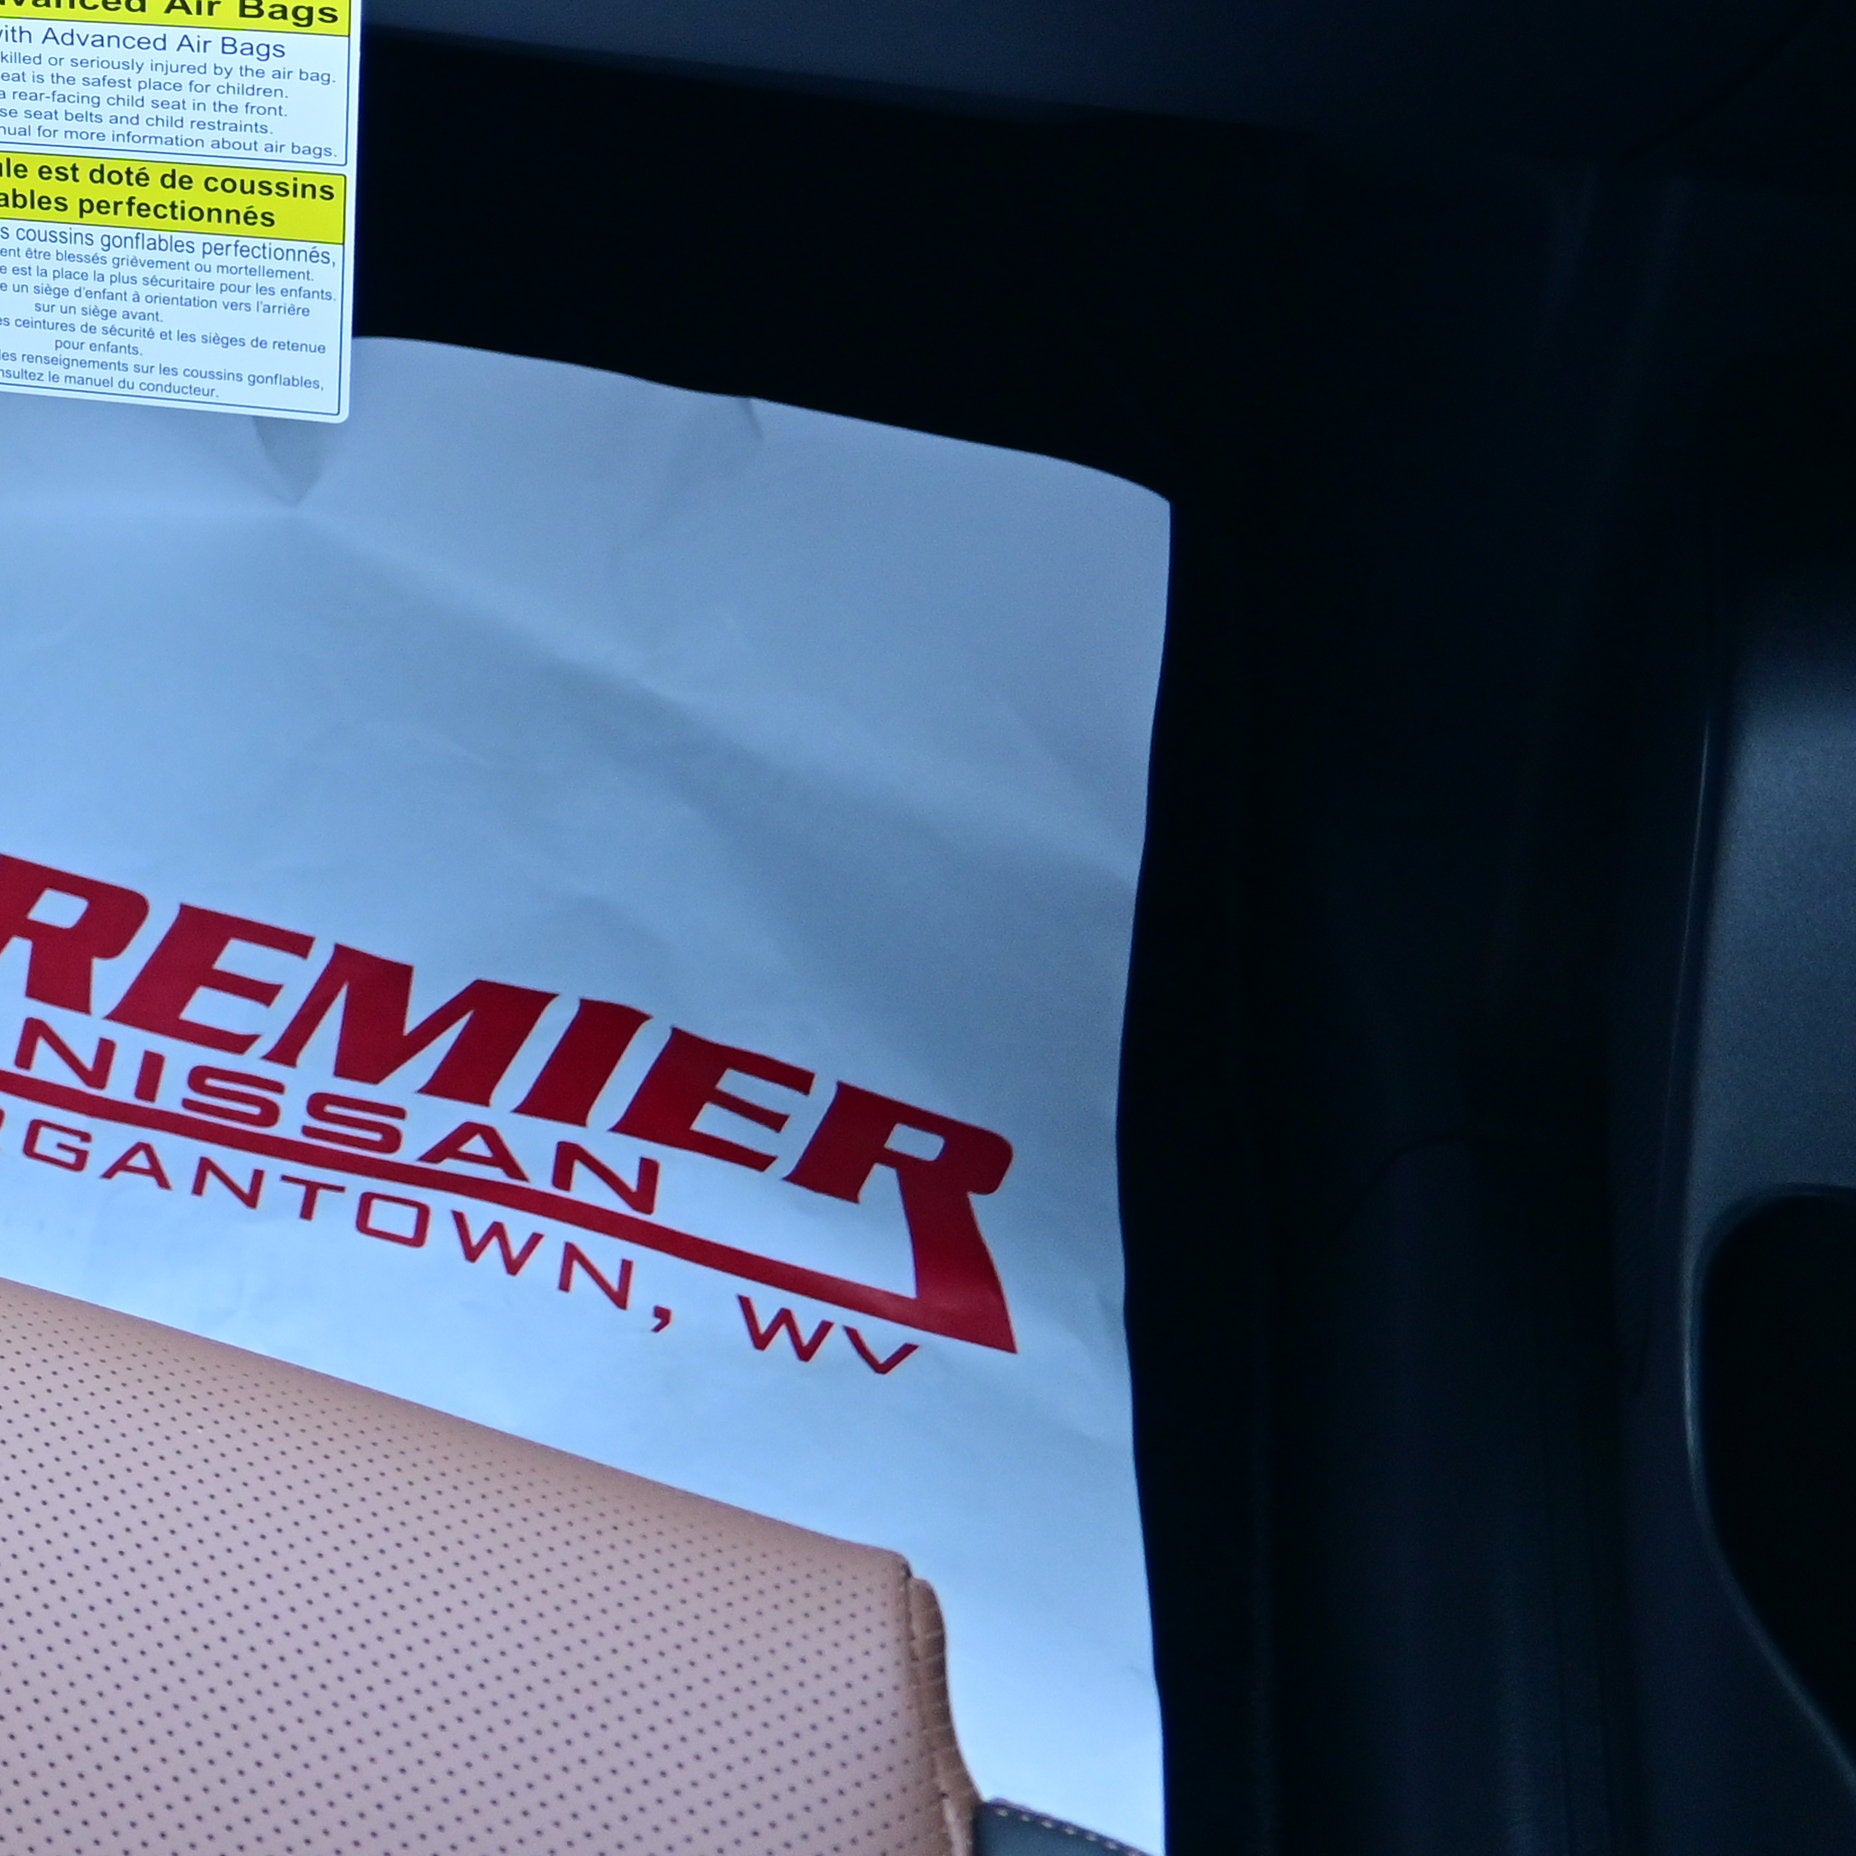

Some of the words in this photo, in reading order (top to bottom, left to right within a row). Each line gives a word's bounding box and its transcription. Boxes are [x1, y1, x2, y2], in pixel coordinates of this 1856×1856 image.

[41, 27, 166, 50] Advanced
[176, 34, 212, 53] Air
[221, 37, 285, 60] Bags
[0, 52, 42, 65] killed
[48, 57, 65, 67] or
[70, 57, 144, 74] seriously
[150, 60, 207, 76] injured
[213, 64, 233, 79] by
[239, 65, 265, 78] the
[271, 68, 293, 80] air
[299, 69, 336, 85] bag.
[32, 71, 45, 84] is
[50, 72, 76, 85] the
[82, 75, 132, 89] safest
[138, 78, 183, 92] place
[188, 80, 211, 93] for
[216, 83, 288, 98] children.
[12, 90, 101, 107] rear-facing
[106, 94, 144, 107] child
[151, 98, 187, 110] seat
[192, 99, 206, 111] in
[213, 100, 239, 113] the
[245, 102, 287, 116] front.
[24, 108, 59, 120] seat
[64, 109, 103, 123] belts
[109, 113, 139, 125] and
[145, 115, 184, 128] child
[190, 119, 273, 134] restraints.
[37, 125, 59, 138] for
[64, 130, 106, 141] more
[112, 130, 204, 148] information
[210, 138, 258, 152] about
[264, 141, 286, 153] air
[291, 142, 337, 158] bags.
[38, 163, 80, 182] est
[89, 165, 150, 187] doté
[160, 169, 193, 190] de
[204, 177, 334, 199] coussins
[79, 198, 275, 226] perfectionnés
[16, 228, 94, 246] coussins
[100, 233, 195, 253] gonflables
[202, 240, 334, 267] perfectionnés,
[25, 247, 51, 260] être
[56, 249, 108, 264] blessés
[112, 255, 190, 271] grièvement
[194, 263, 212, 272] ou
[216, 264, 314, 280] mortellement.
[13, 1013, 664, 1216] NISSAN
[736, 1294, 922, 1377] WV
